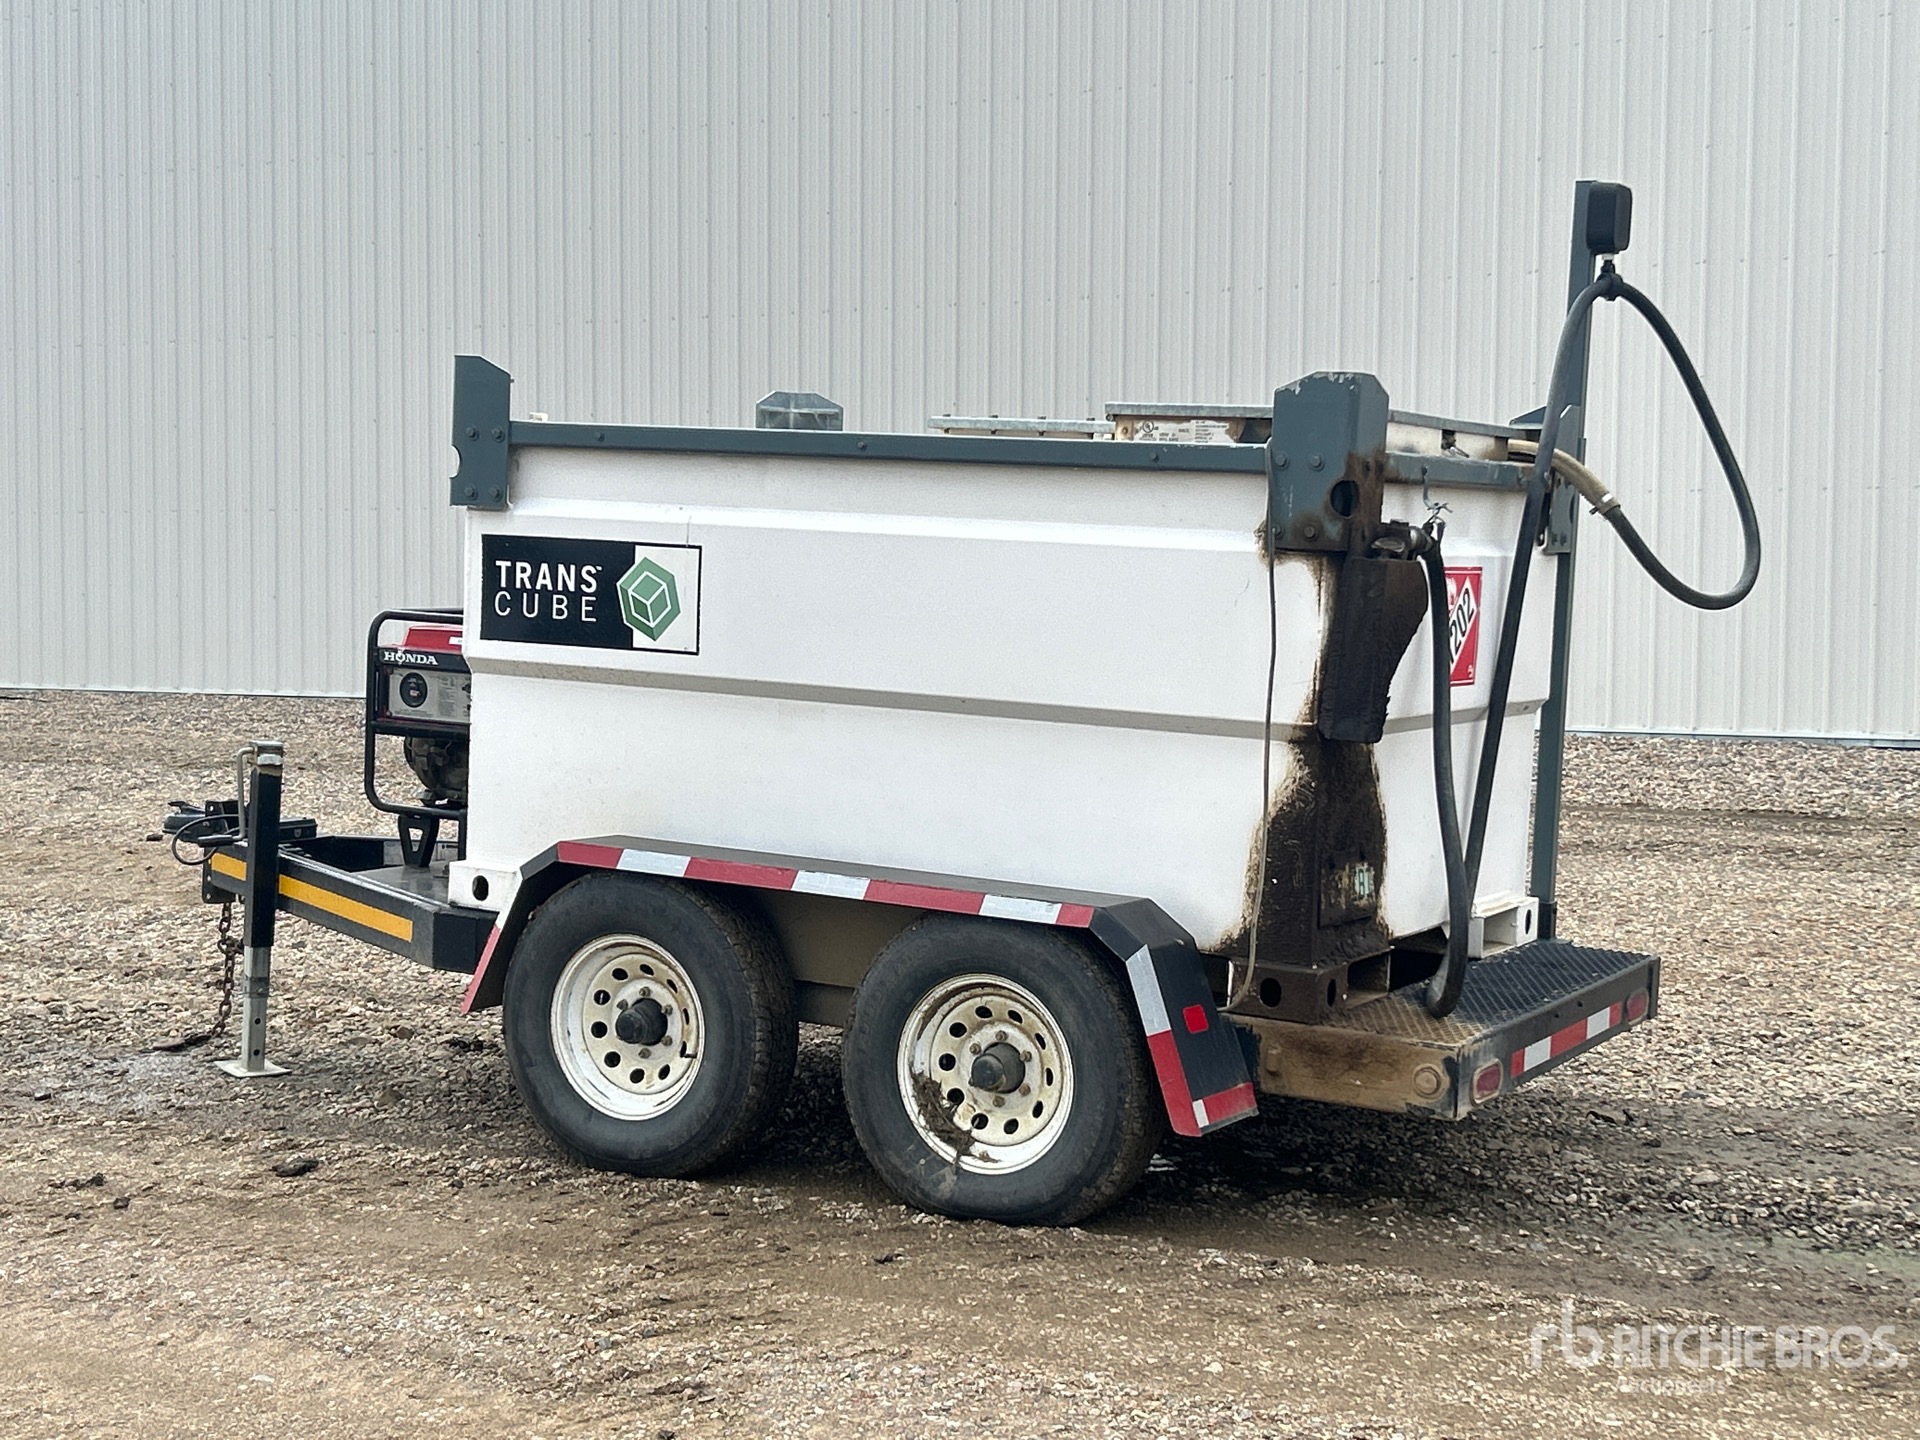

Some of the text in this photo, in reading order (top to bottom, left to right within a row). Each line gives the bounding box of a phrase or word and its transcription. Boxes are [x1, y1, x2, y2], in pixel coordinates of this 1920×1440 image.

[495, 560, 597, 593] TRANS
[494, 590, 597, 622] CUBE
[1450, 587, 1475, 665] 202
[383, 650, 439, 666] HONDA
